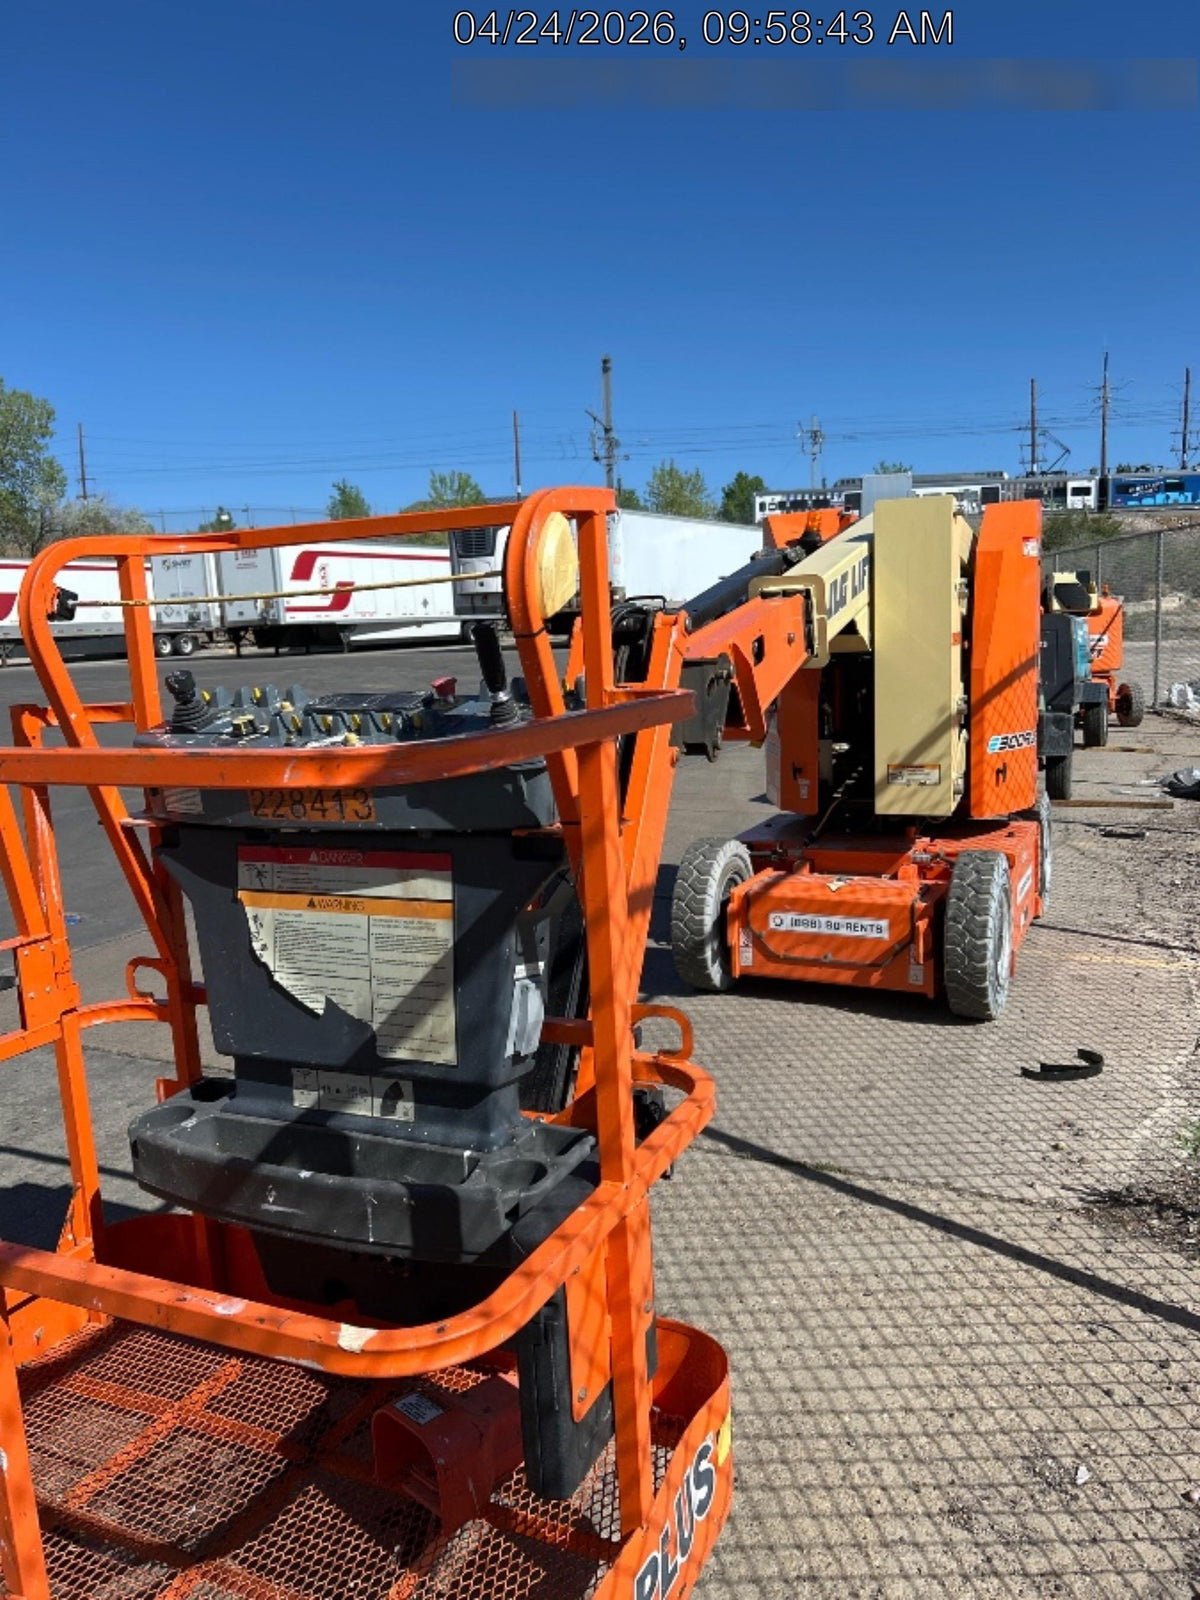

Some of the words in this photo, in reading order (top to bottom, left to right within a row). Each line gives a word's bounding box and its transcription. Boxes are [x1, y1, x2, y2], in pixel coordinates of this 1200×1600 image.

[851, 553, 870, 600] LIF
[250, 788, 372, 820] 228413
[318, 850, 364, 864] DANGER
[317, 899, 366, 912] WARNING
[635, 1441, 715, 1600] PLUS
